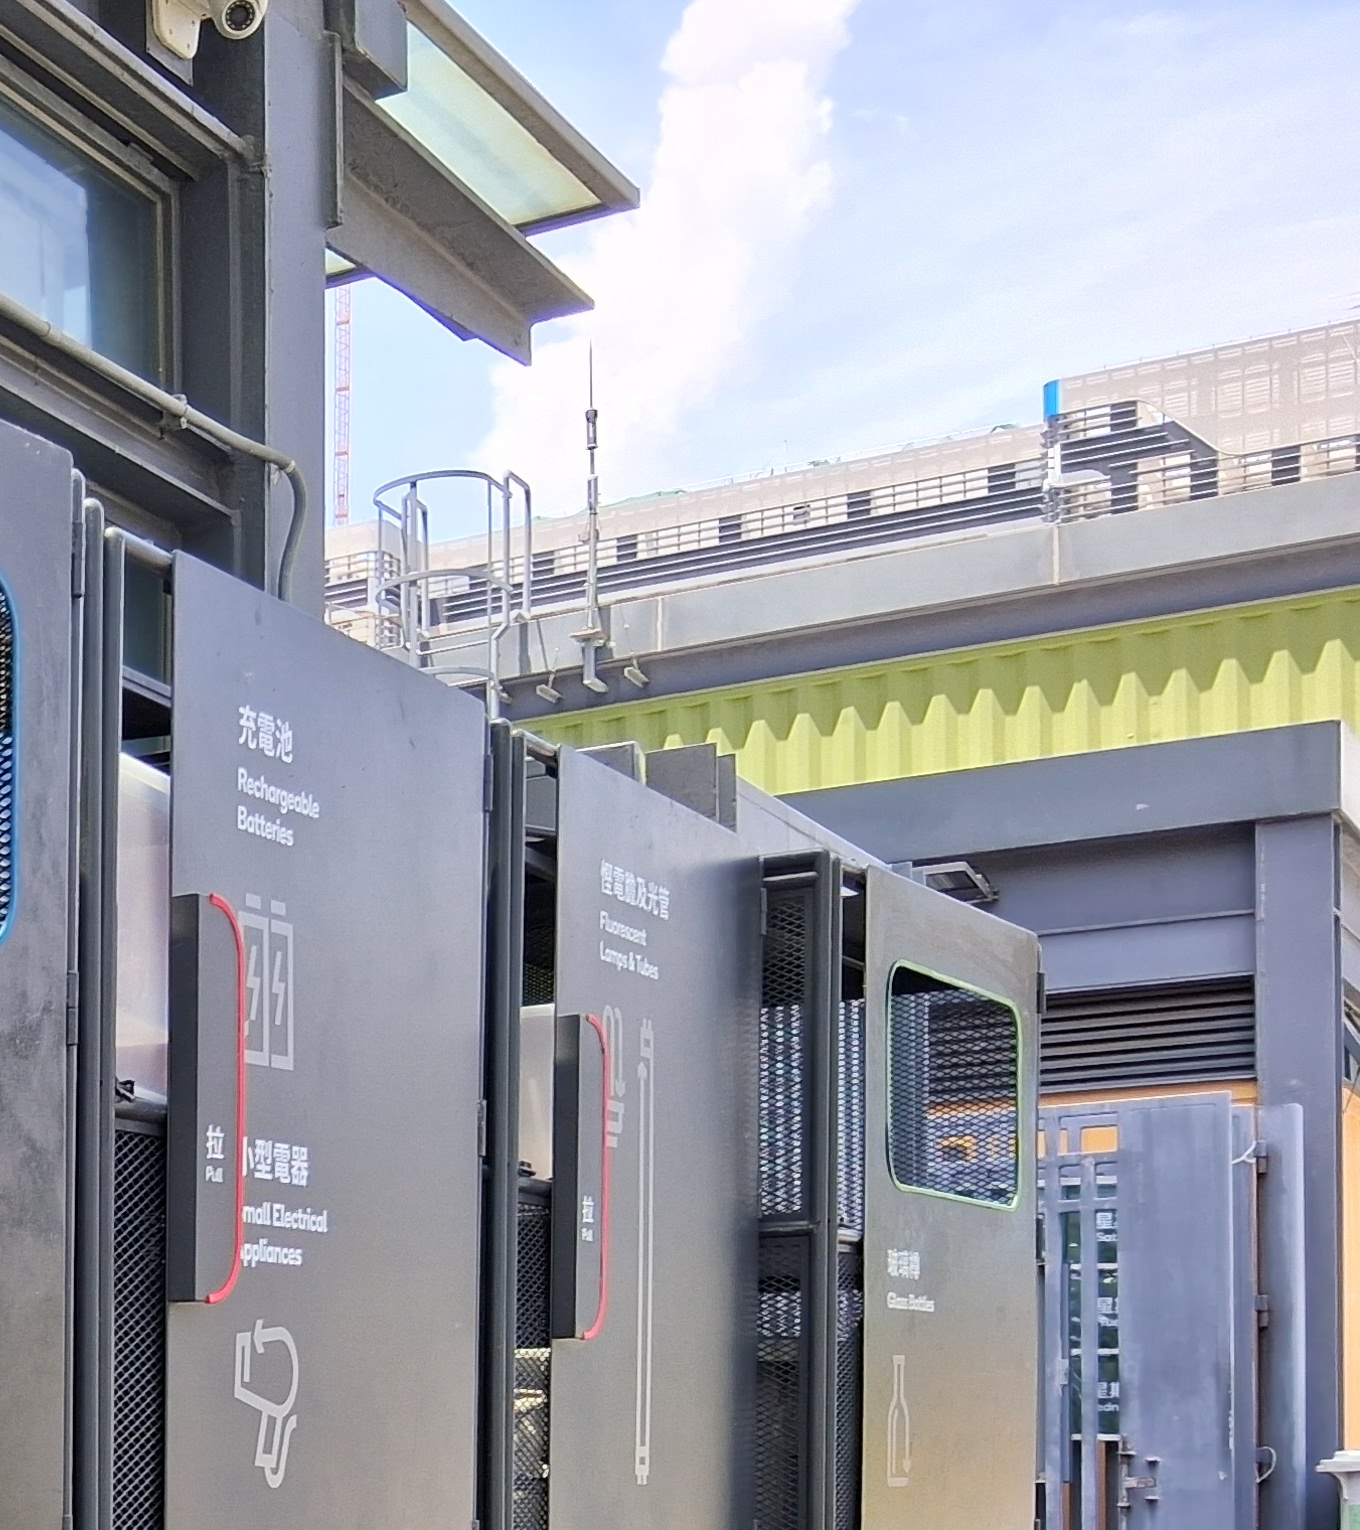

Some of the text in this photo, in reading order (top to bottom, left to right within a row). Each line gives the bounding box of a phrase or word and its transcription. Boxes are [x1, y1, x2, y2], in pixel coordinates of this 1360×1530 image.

[238, 704, 293, 764] 充電池
[237, 766, 320, 819] Rechargeable
[237, 804, 294, 847] Batteries
[600, 910, 647, 946] Fluorescent
[600, 940, 659, 980] Lamps & Tubes
[205, 1124, 226, 1160] 拉
[205, 1165, 224, 1183] Pull
[241, 1136, 309, 1187] 小型電器
[241, 1201, 328, 1233] mall Electrical
[240, 1238, 303, 1268] ppliances
